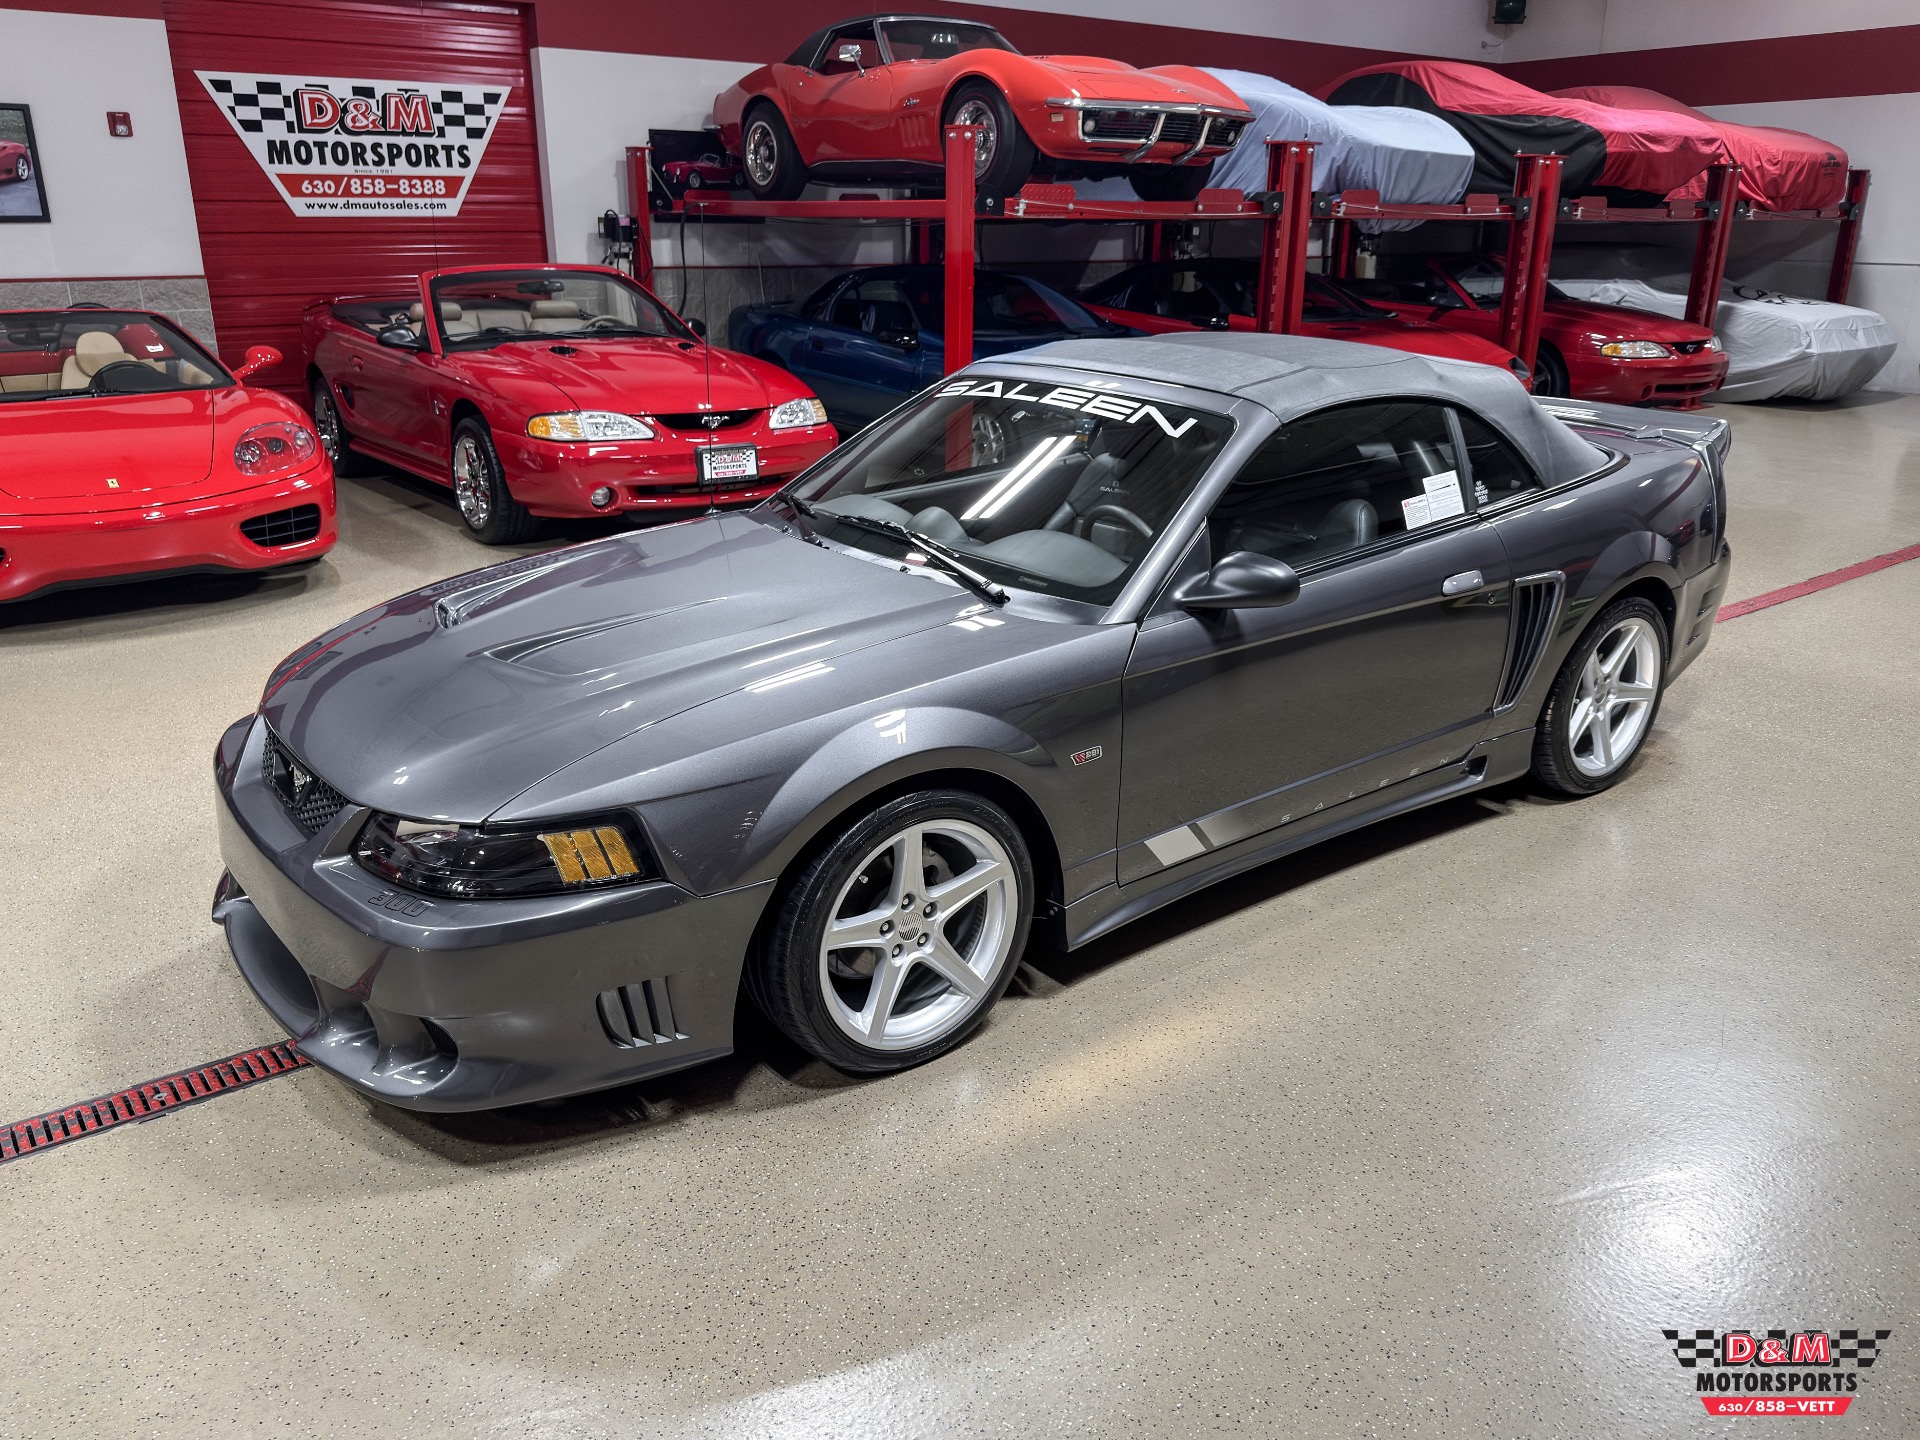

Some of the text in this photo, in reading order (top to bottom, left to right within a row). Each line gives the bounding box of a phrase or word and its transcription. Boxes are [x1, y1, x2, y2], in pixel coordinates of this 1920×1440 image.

[295, 89, 437, 137] D&M
[267, 139, 471, 168] MOTORSPORTS
[304, 200, 447, 211] www.dmautosales.com
[934, 379, 1198, 439] SALEEN
[713, 463, 747, 471] MOTORSPORTS
[368, 888, 436, 917] 300
